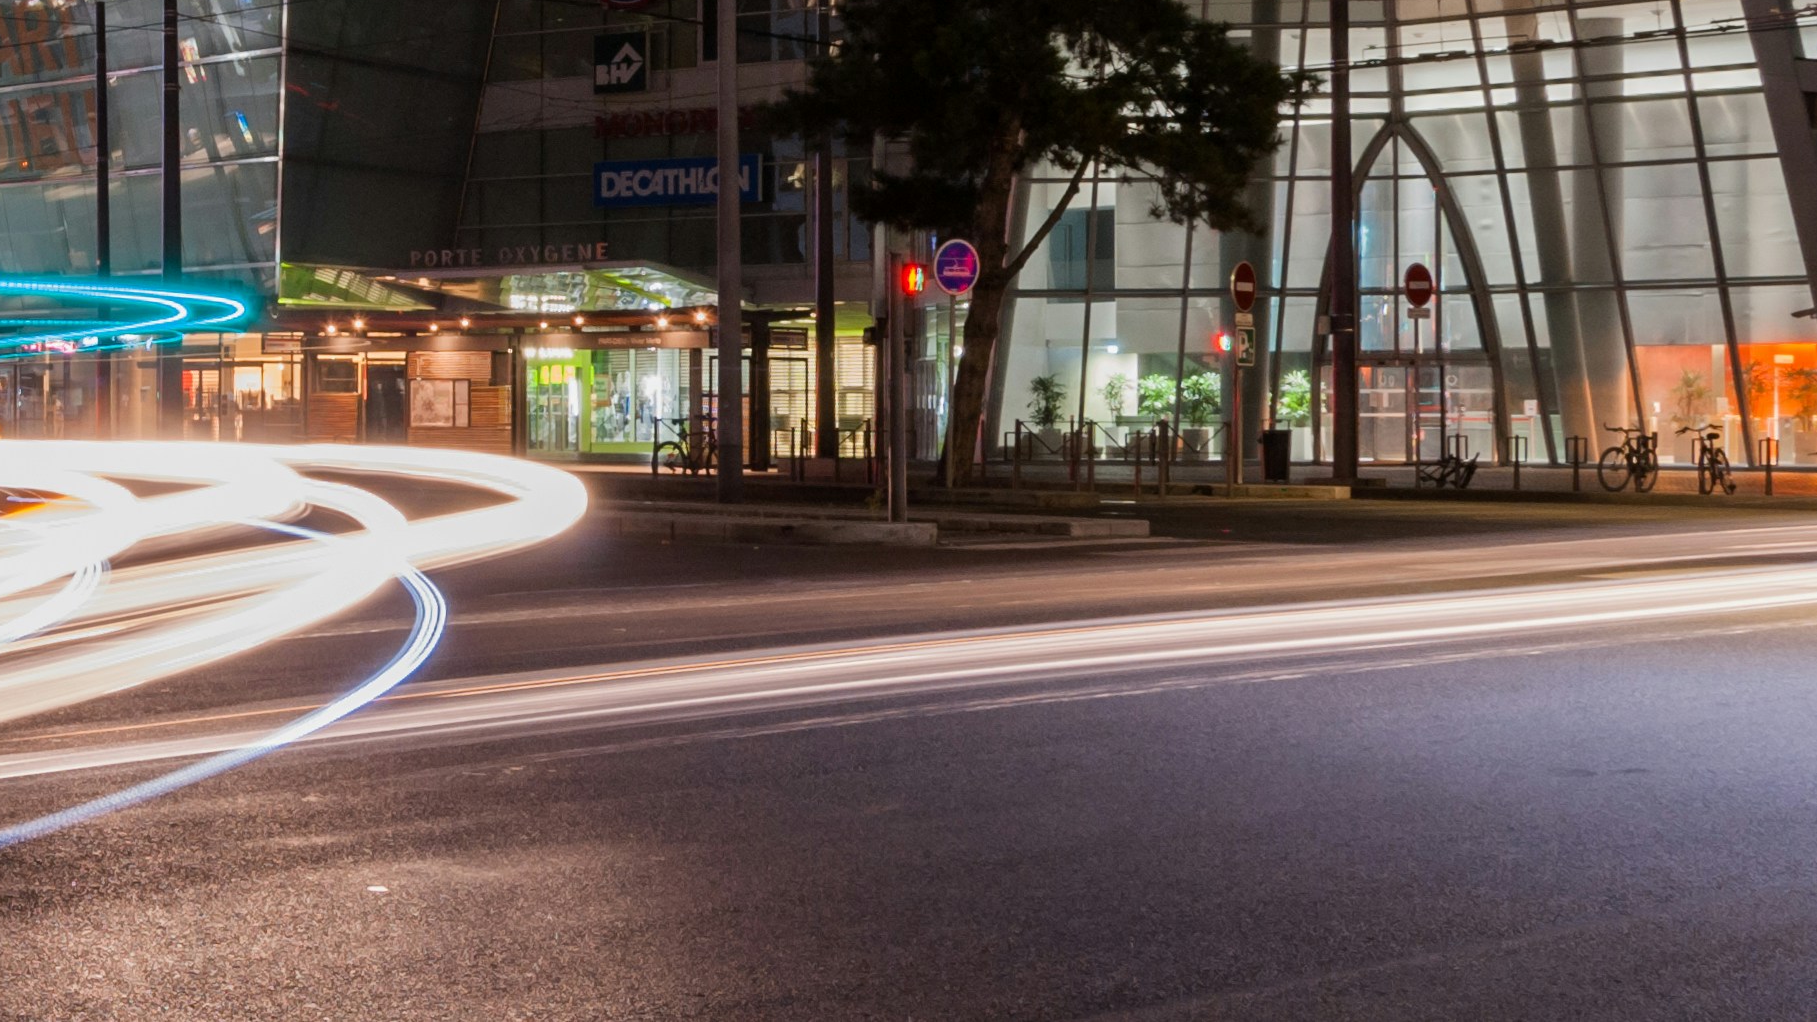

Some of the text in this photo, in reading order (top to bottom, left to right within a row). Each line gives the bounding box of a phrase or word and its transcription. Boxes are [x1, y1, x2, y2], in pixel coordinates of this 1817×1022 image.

[595, 59, 643, 86] BHV
[594, 105, 755, 139] MONOPRX
[600, 165, 750, 198] DECATHLON
[410, 242, 609, 267] PORTE OXYGENE
